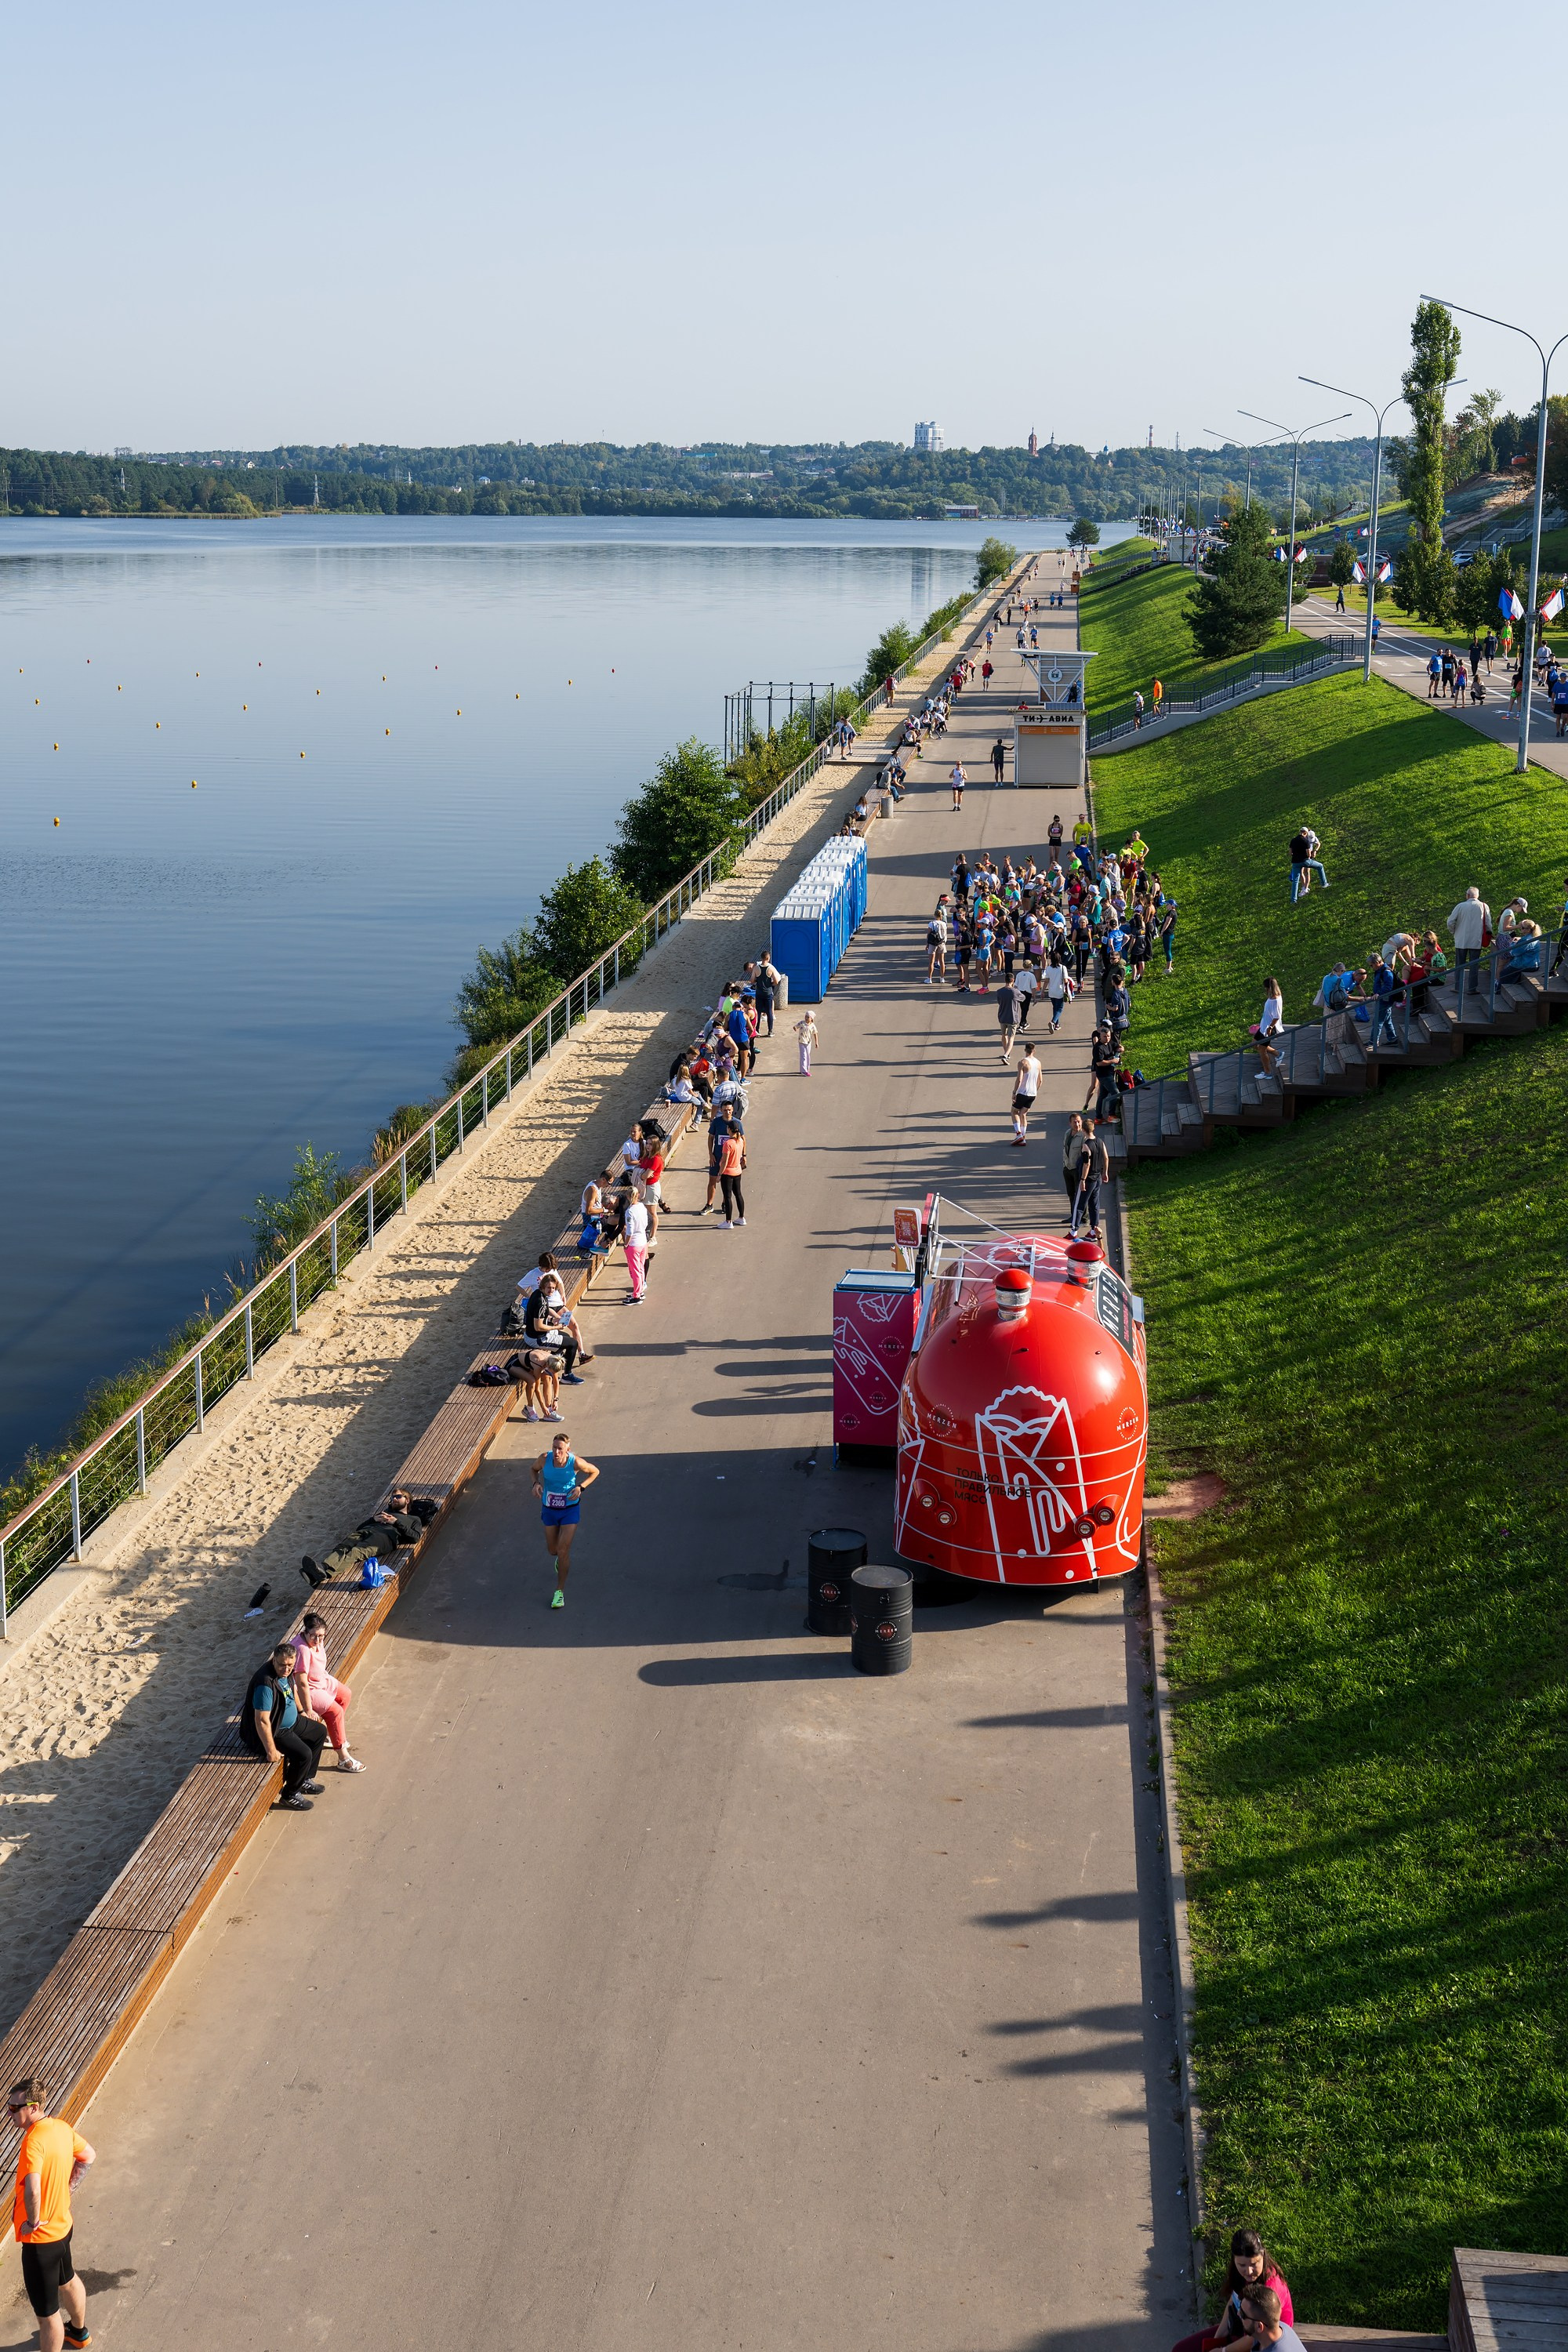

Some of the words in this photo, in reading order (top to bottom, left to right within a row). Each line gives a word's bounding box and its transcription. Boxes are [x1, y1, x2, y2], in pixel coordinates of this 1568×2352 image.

[1102, 1268, 1120, 1337] MERZEN
[927, 1413, 957, 1428] MERZEN
[1116, 1416, 1138, 1432] MERZEN
[956, 1467, 1000, 1483] ТОЛЬКО
[954, 1479, 1031, 1497] ПРАВИЛЬНОЕ
[954, 1490, 987, 1504] МЯСО
